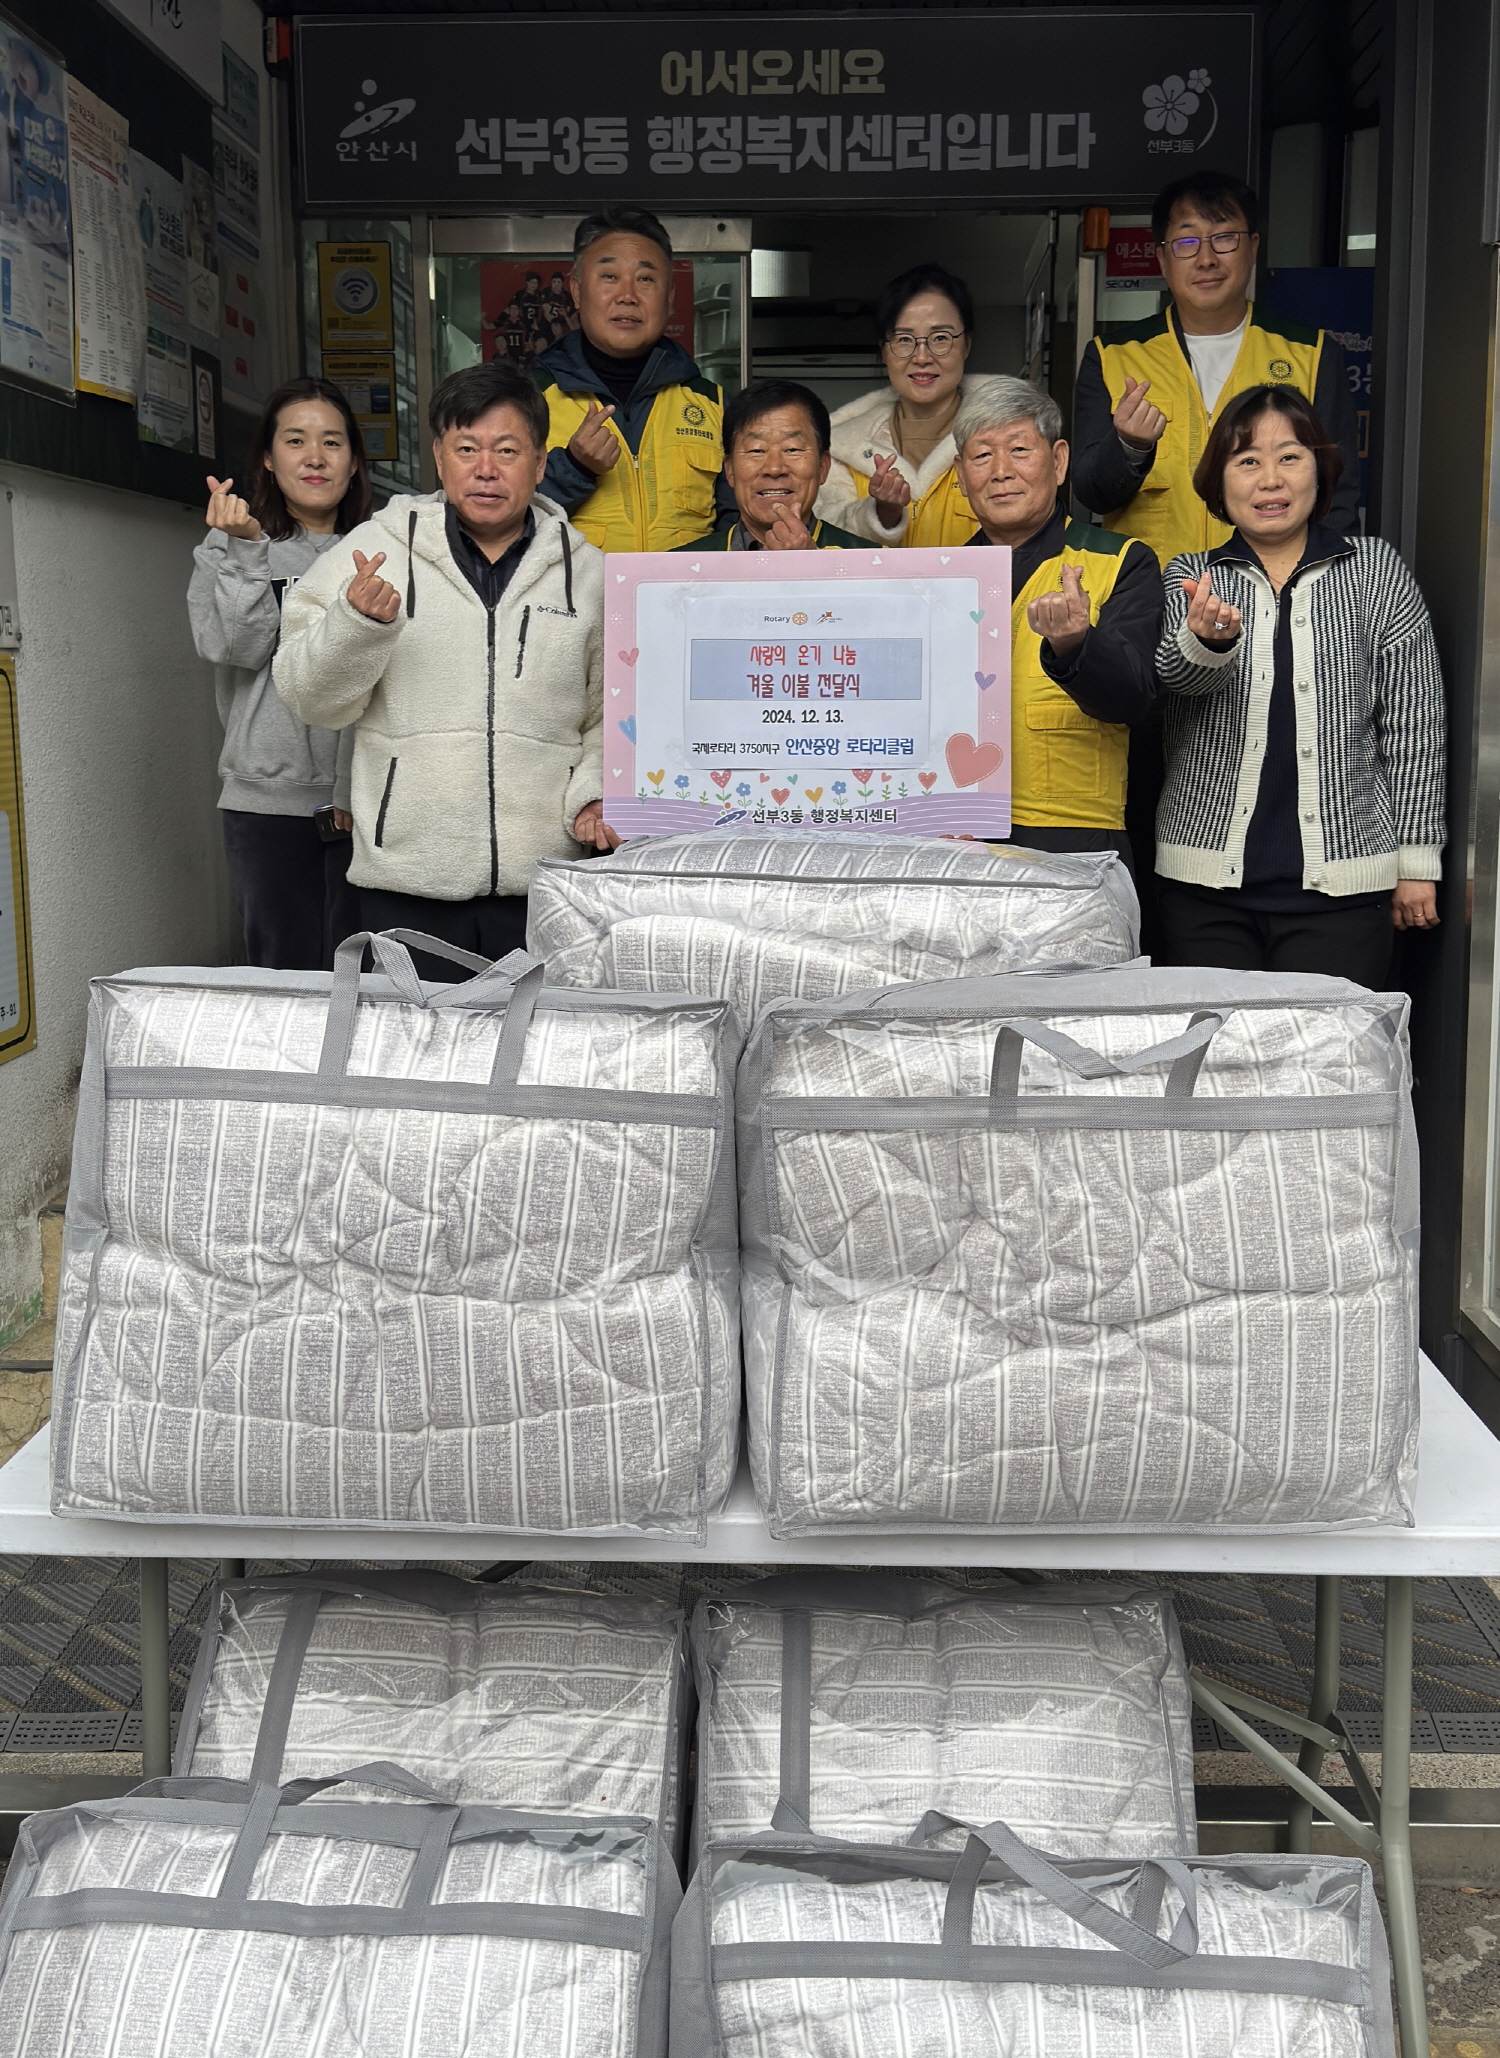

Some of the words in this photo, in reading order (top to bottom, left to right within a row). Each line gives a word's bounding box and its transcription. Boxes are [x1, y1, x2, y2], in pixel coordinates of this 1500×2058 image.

[661, 49, 885, 95] 어서오세요
[335, 140, 417, 161] 안산시
[456, 116, 629, 174] 선부3동
[647, 112, 1096, 174] 행정복지센터입니다
[1147, 139, 1195, 154] 선부3동
[1115, 241, 1156, 258] 에스원
[1105, 279, 1140, 288] SECOM
[527, 307, 535, 319] 2
[509, 335, 520, 347] 11
[764, 615, 790, 624] Rotary
[750, 645, 785, 666] 사랑의
[798, 644, 821, 666] 온기
[833, 644, 856, 666] 나눔
[746, 674, 774, 698] 겨울
[782, 673, 810, 698] 이불
[817, 673, 860, 698] 전달식
[762, 709, 795, 723] 2024.
[801, 709, 819, 723] 12.
[825, 709, 843, 723] 13.
[692, 742, 736, 755] 국제로타리
[739, 742, 780, 755] 3750지구
[785, 738, 840, 755] 안산중앙
[846, 738, 914, 755] 로타리클럽
[752, 808, 803, 824] 선부3동
[811, 808, 897, 823] 행정복지센터
